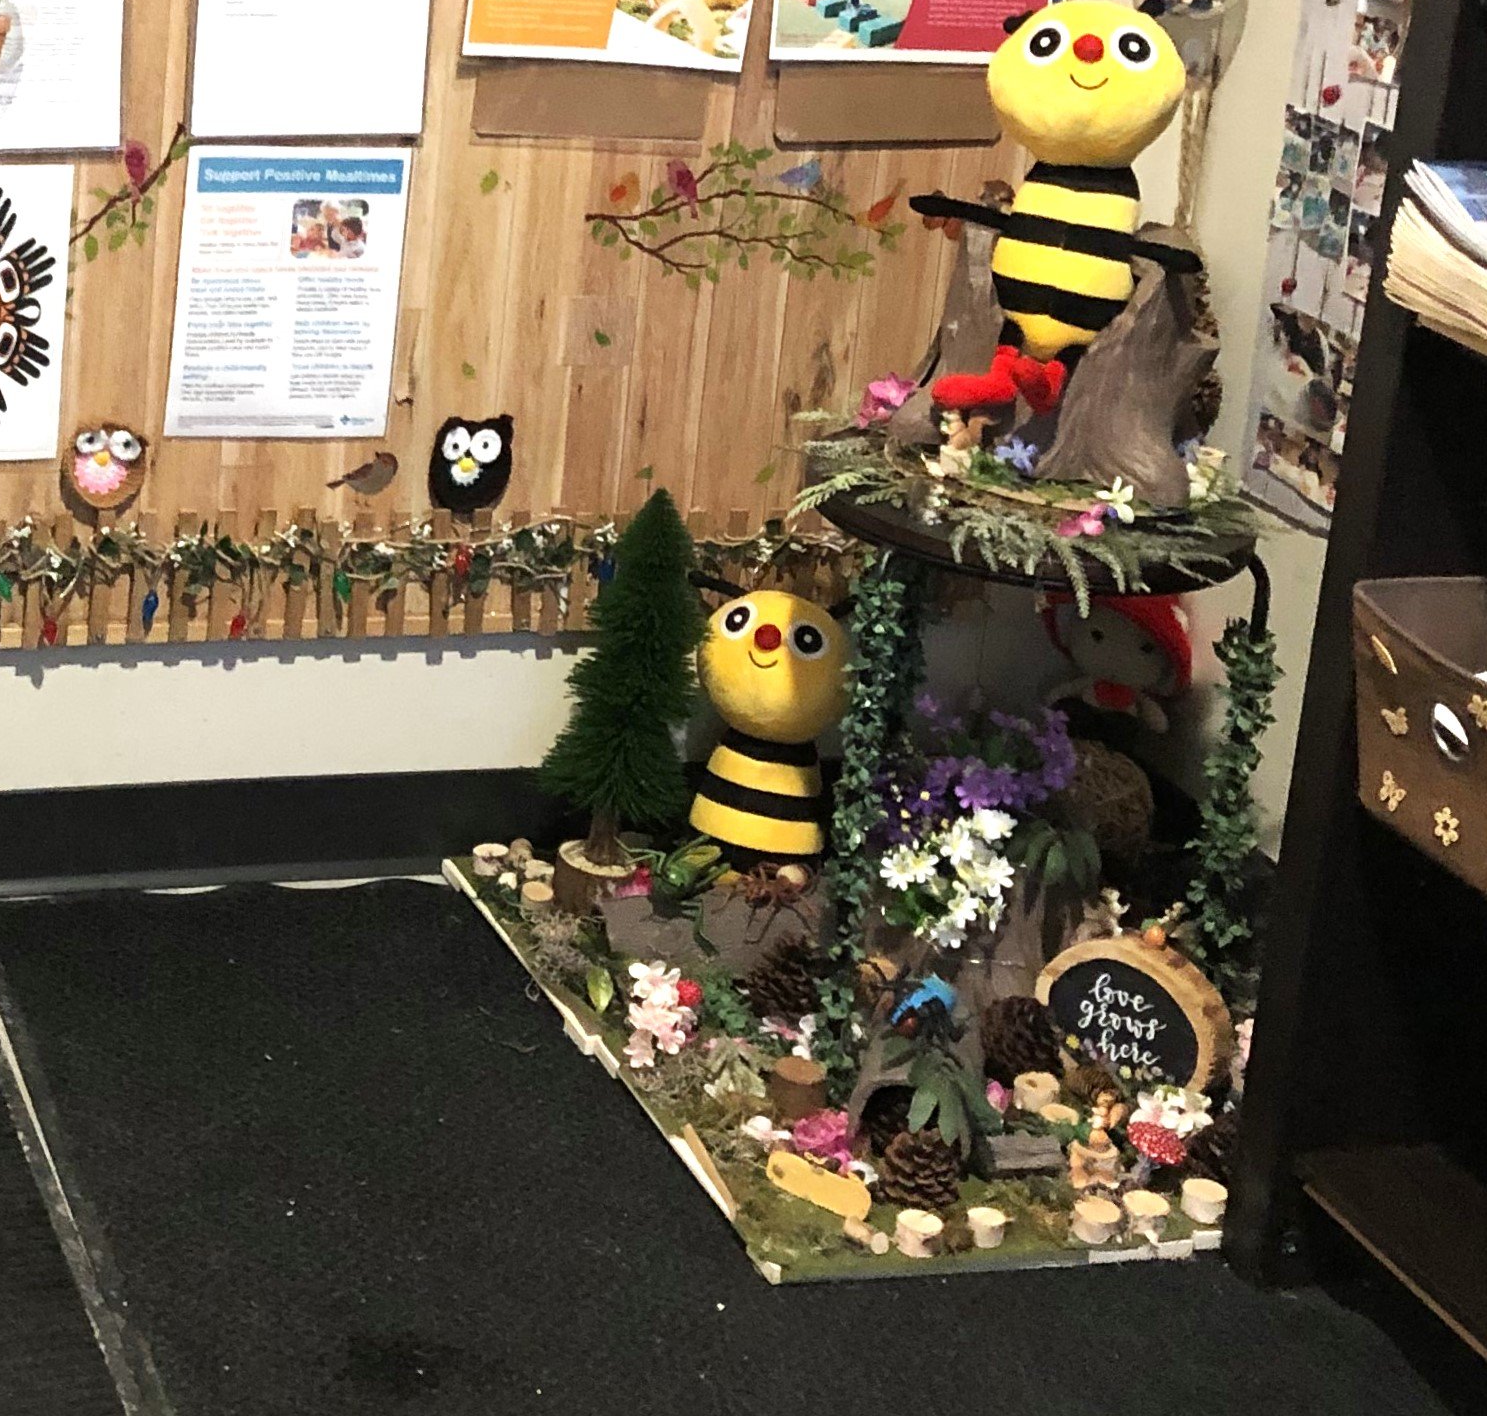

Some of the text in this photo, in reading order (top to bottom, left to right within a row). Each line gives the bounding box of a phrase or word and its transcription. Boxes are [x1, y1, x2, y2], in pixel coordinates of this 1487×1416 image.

[204, 167, 397, 184] Support Positive Mealtimes
[1088, 972, 1154, 1012] love
[1078, 999, 1167, 1041] grows
[1096, 1029, 1160, 1065] here
